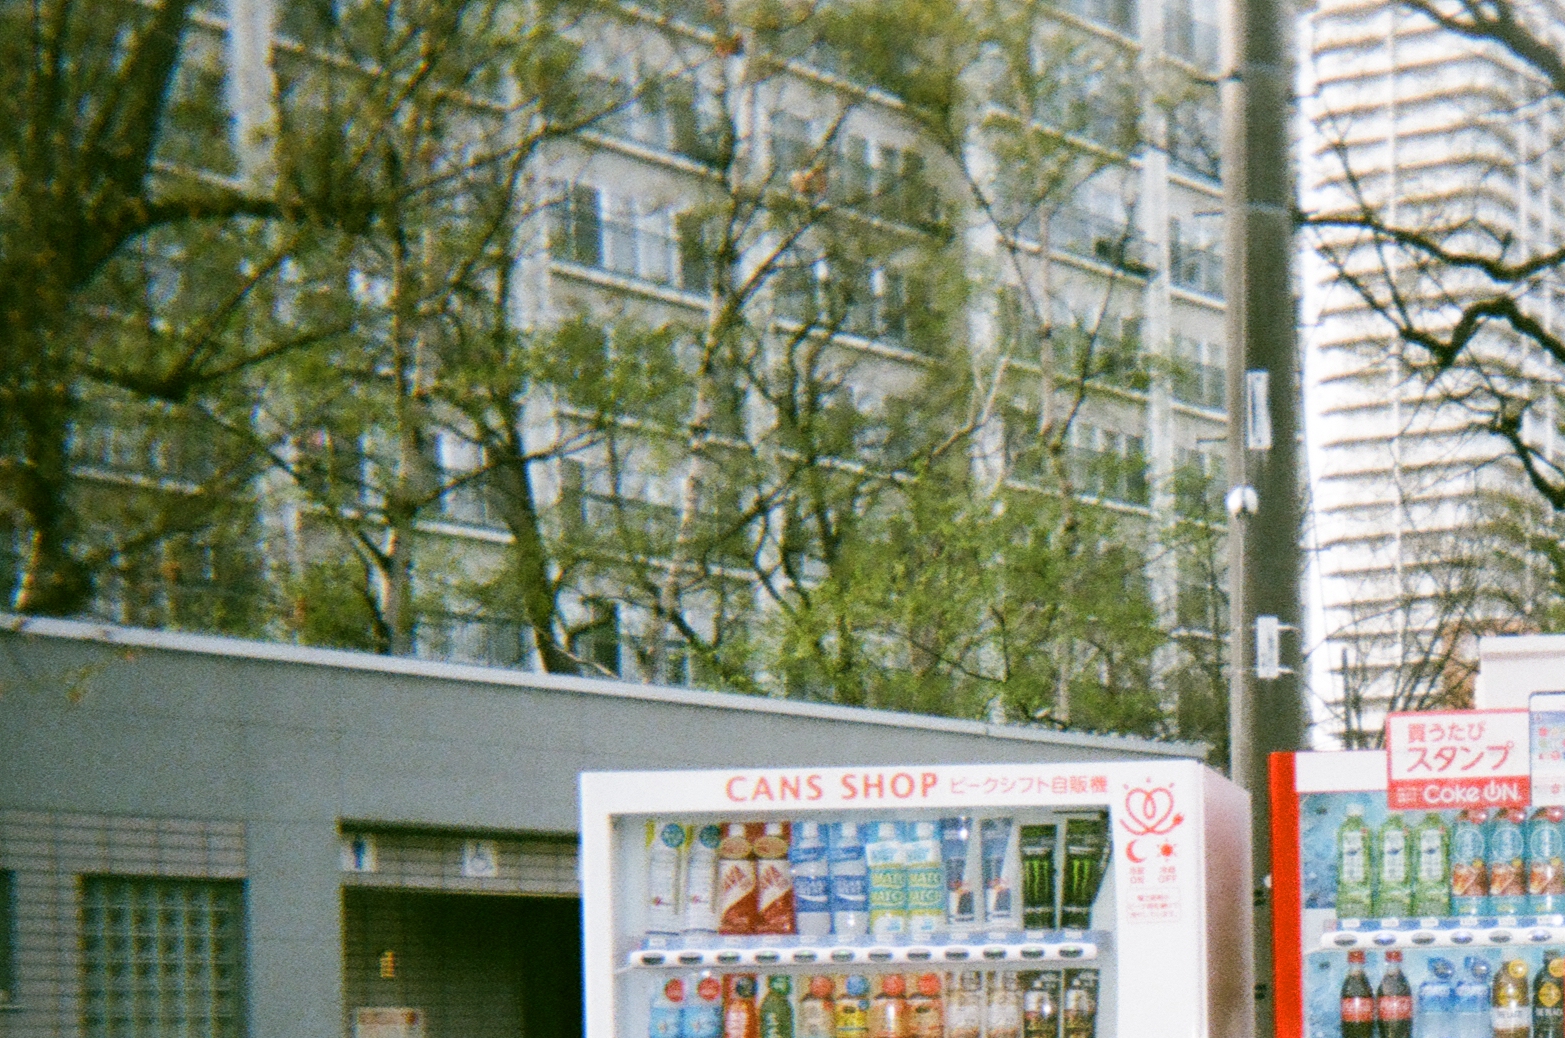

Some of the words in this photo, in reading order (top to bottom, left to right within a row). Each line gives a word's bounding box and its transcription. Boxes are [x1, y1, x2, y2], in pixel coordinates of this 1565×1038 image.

[1408, 722, 1486, 743] 買うたび
[1407, 742, 1515, 772] スタンプ
[725, 775, 823, 801] CANS
[841, 772, 938, 799] SHOP
[1423, 783, 1480, 803] Coke
